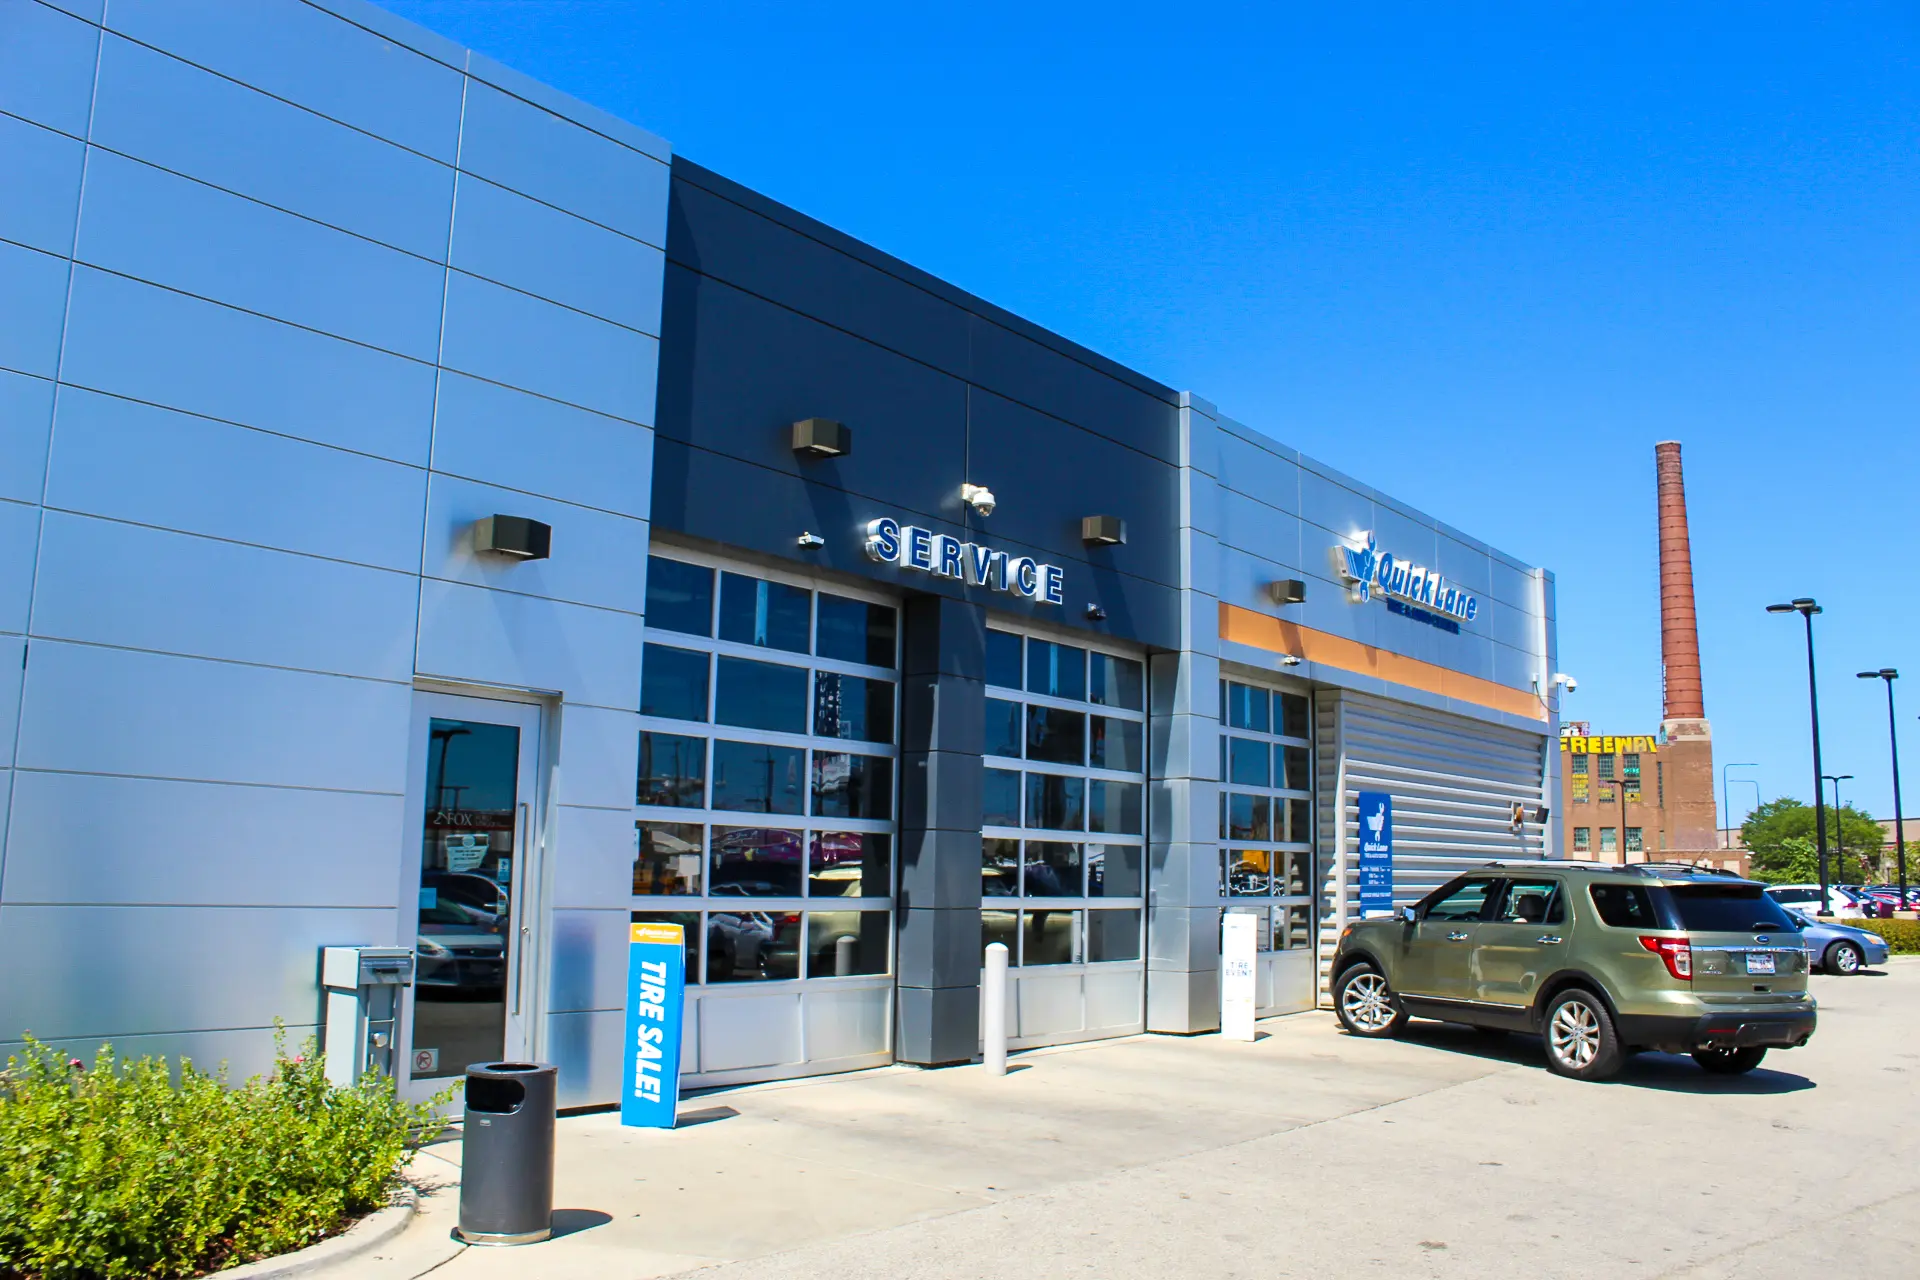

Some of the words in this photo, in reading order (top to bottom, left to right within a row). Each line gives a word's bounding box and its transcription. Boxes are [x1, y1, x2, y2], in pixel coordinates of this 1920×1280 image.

[866, 517, 1063, 605] SERVICE
[1377, 551, 1433, 606] Quick
[1434, 573, 1477, 621] Lane
[639, 961, 667, 1022] TIRE
[634, 1023, 663, 1103] SALE!
